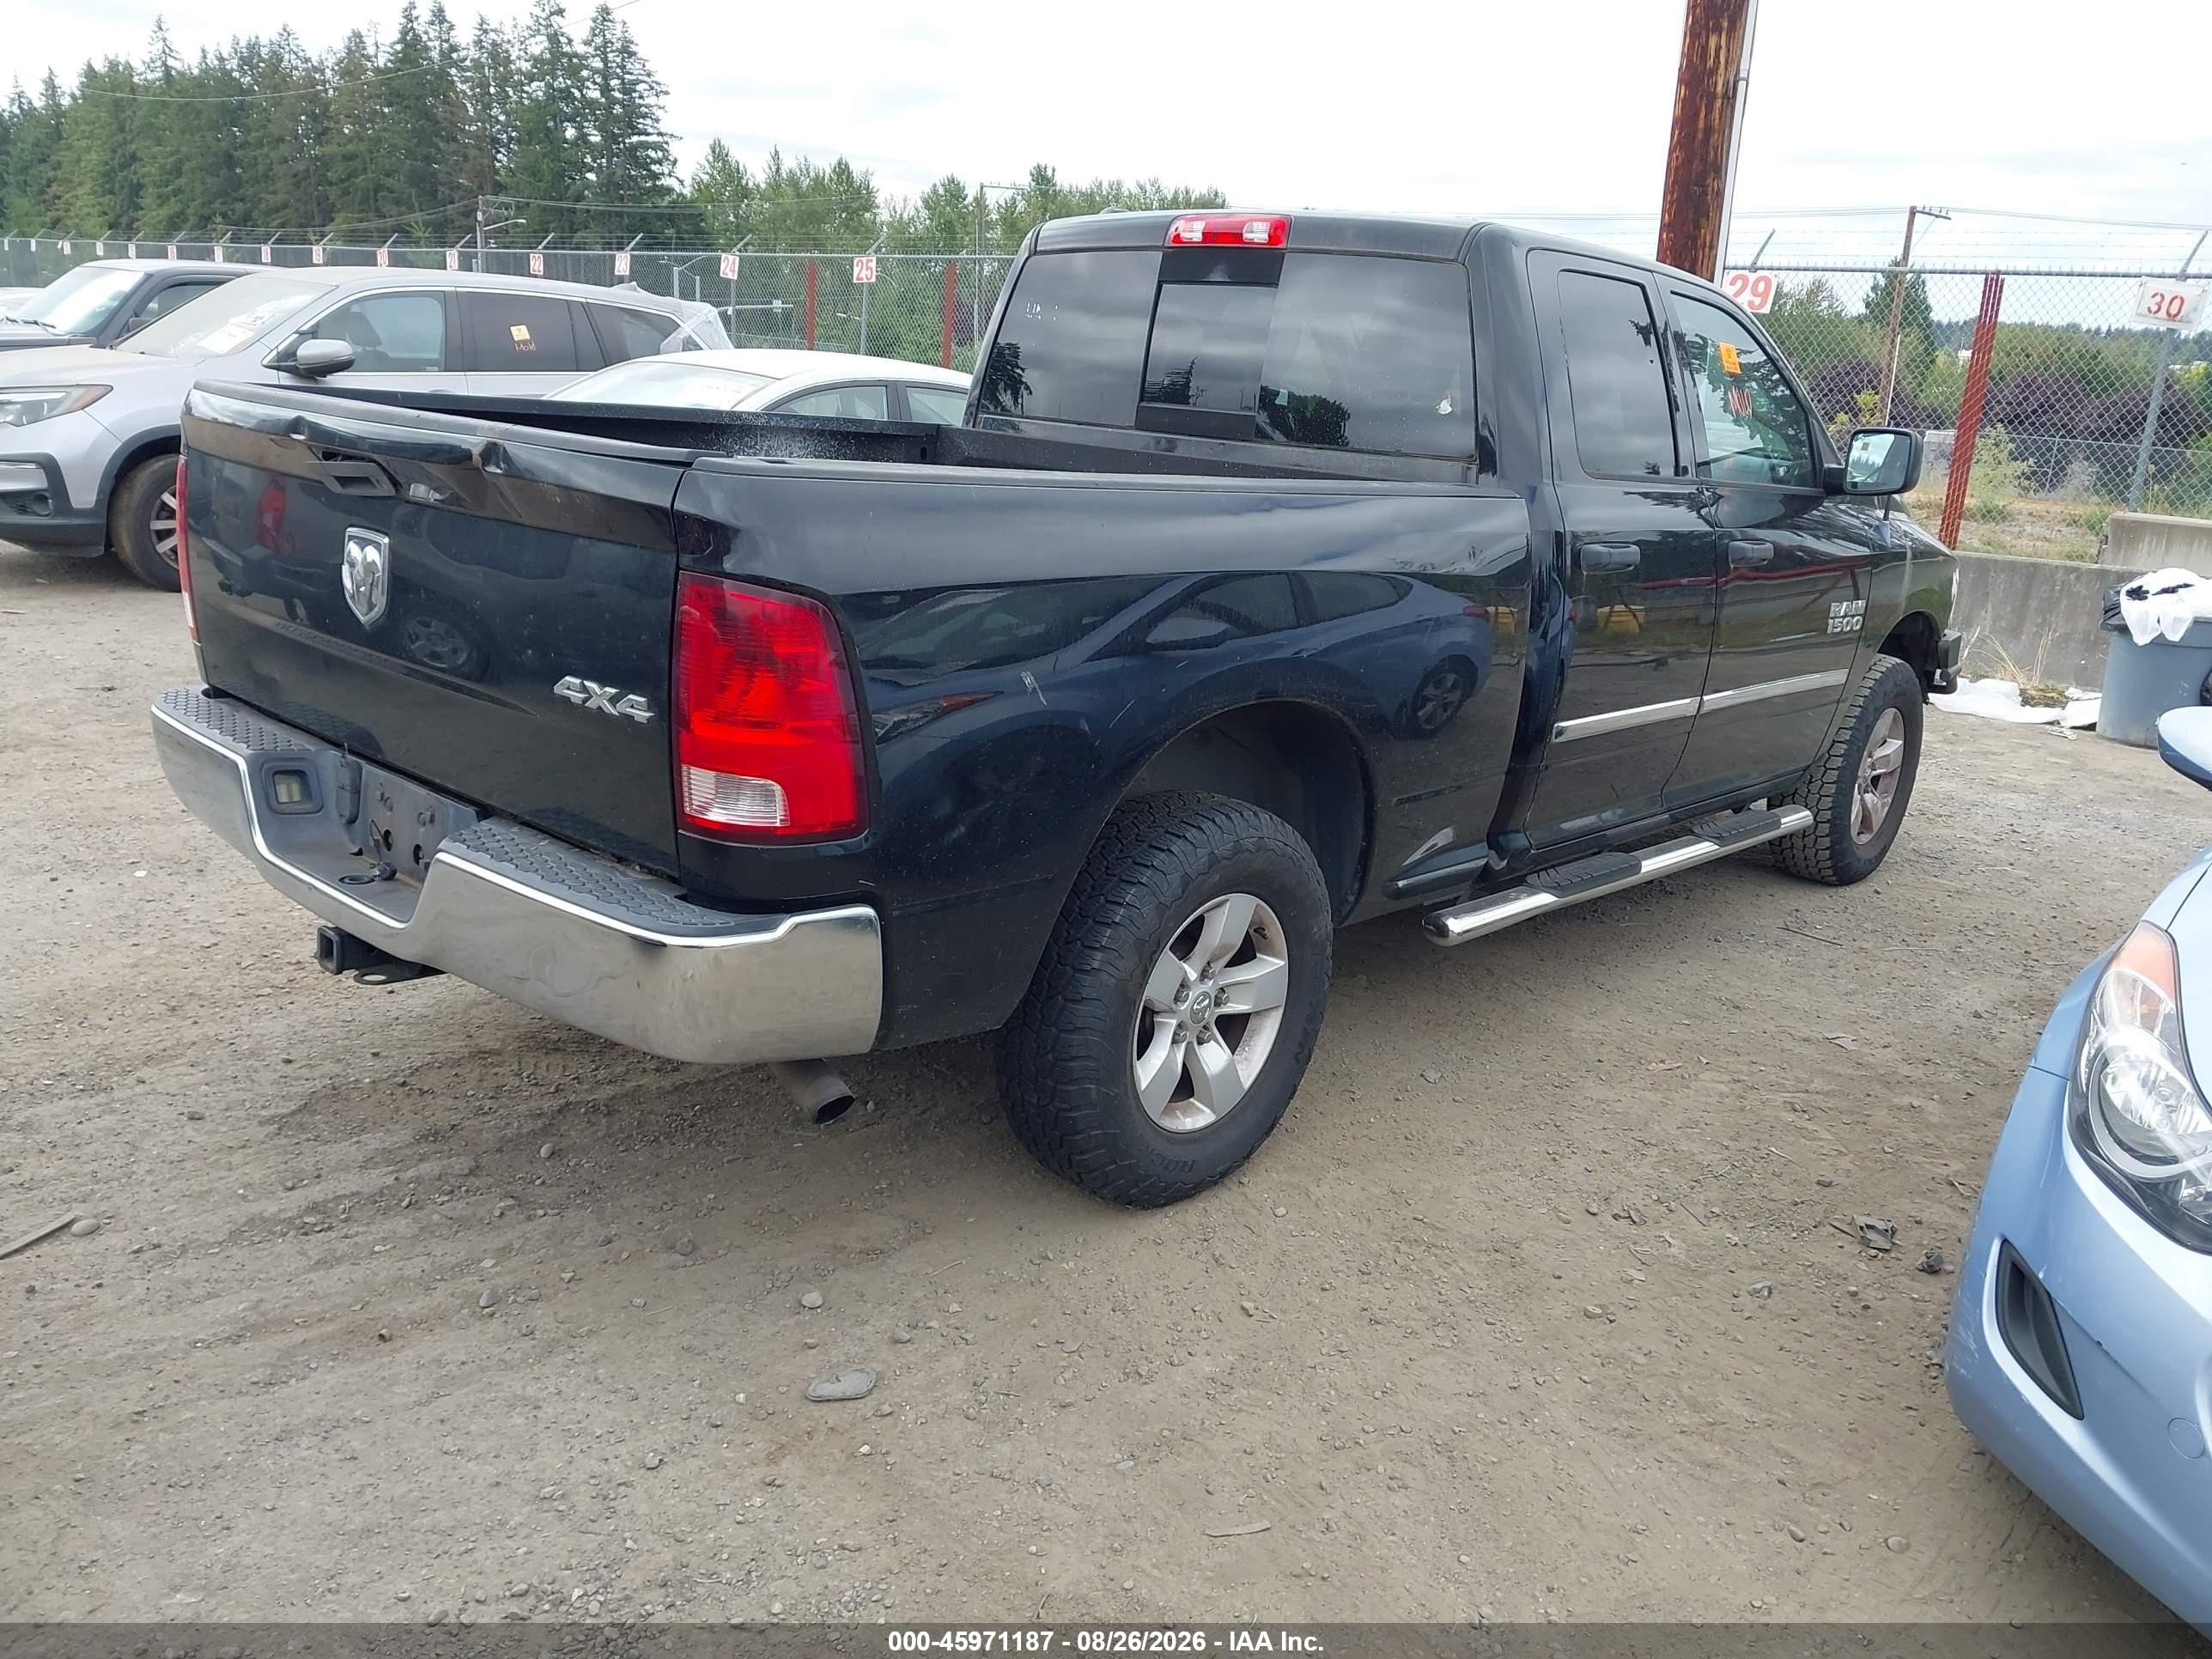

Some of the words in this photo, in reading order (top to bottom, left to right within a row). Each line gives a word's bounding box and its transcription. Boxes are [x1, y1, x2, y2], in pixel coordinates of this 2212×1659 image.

[447, 251, 458, 270] 21
[531, 254, 543, 273] 22
[616, 255, 629, 274] 23
[722, 255, 737, 277] 24
[855, 258, 873, 282] 25
[1729, 274, 1772, 310] 29
[2147, 291, 2185, 319] 30
[1829, 599, 1866, 617] RAM
[1826, 616, 1863, 634] 1500
[553, 675, 657, 723] 4X4
